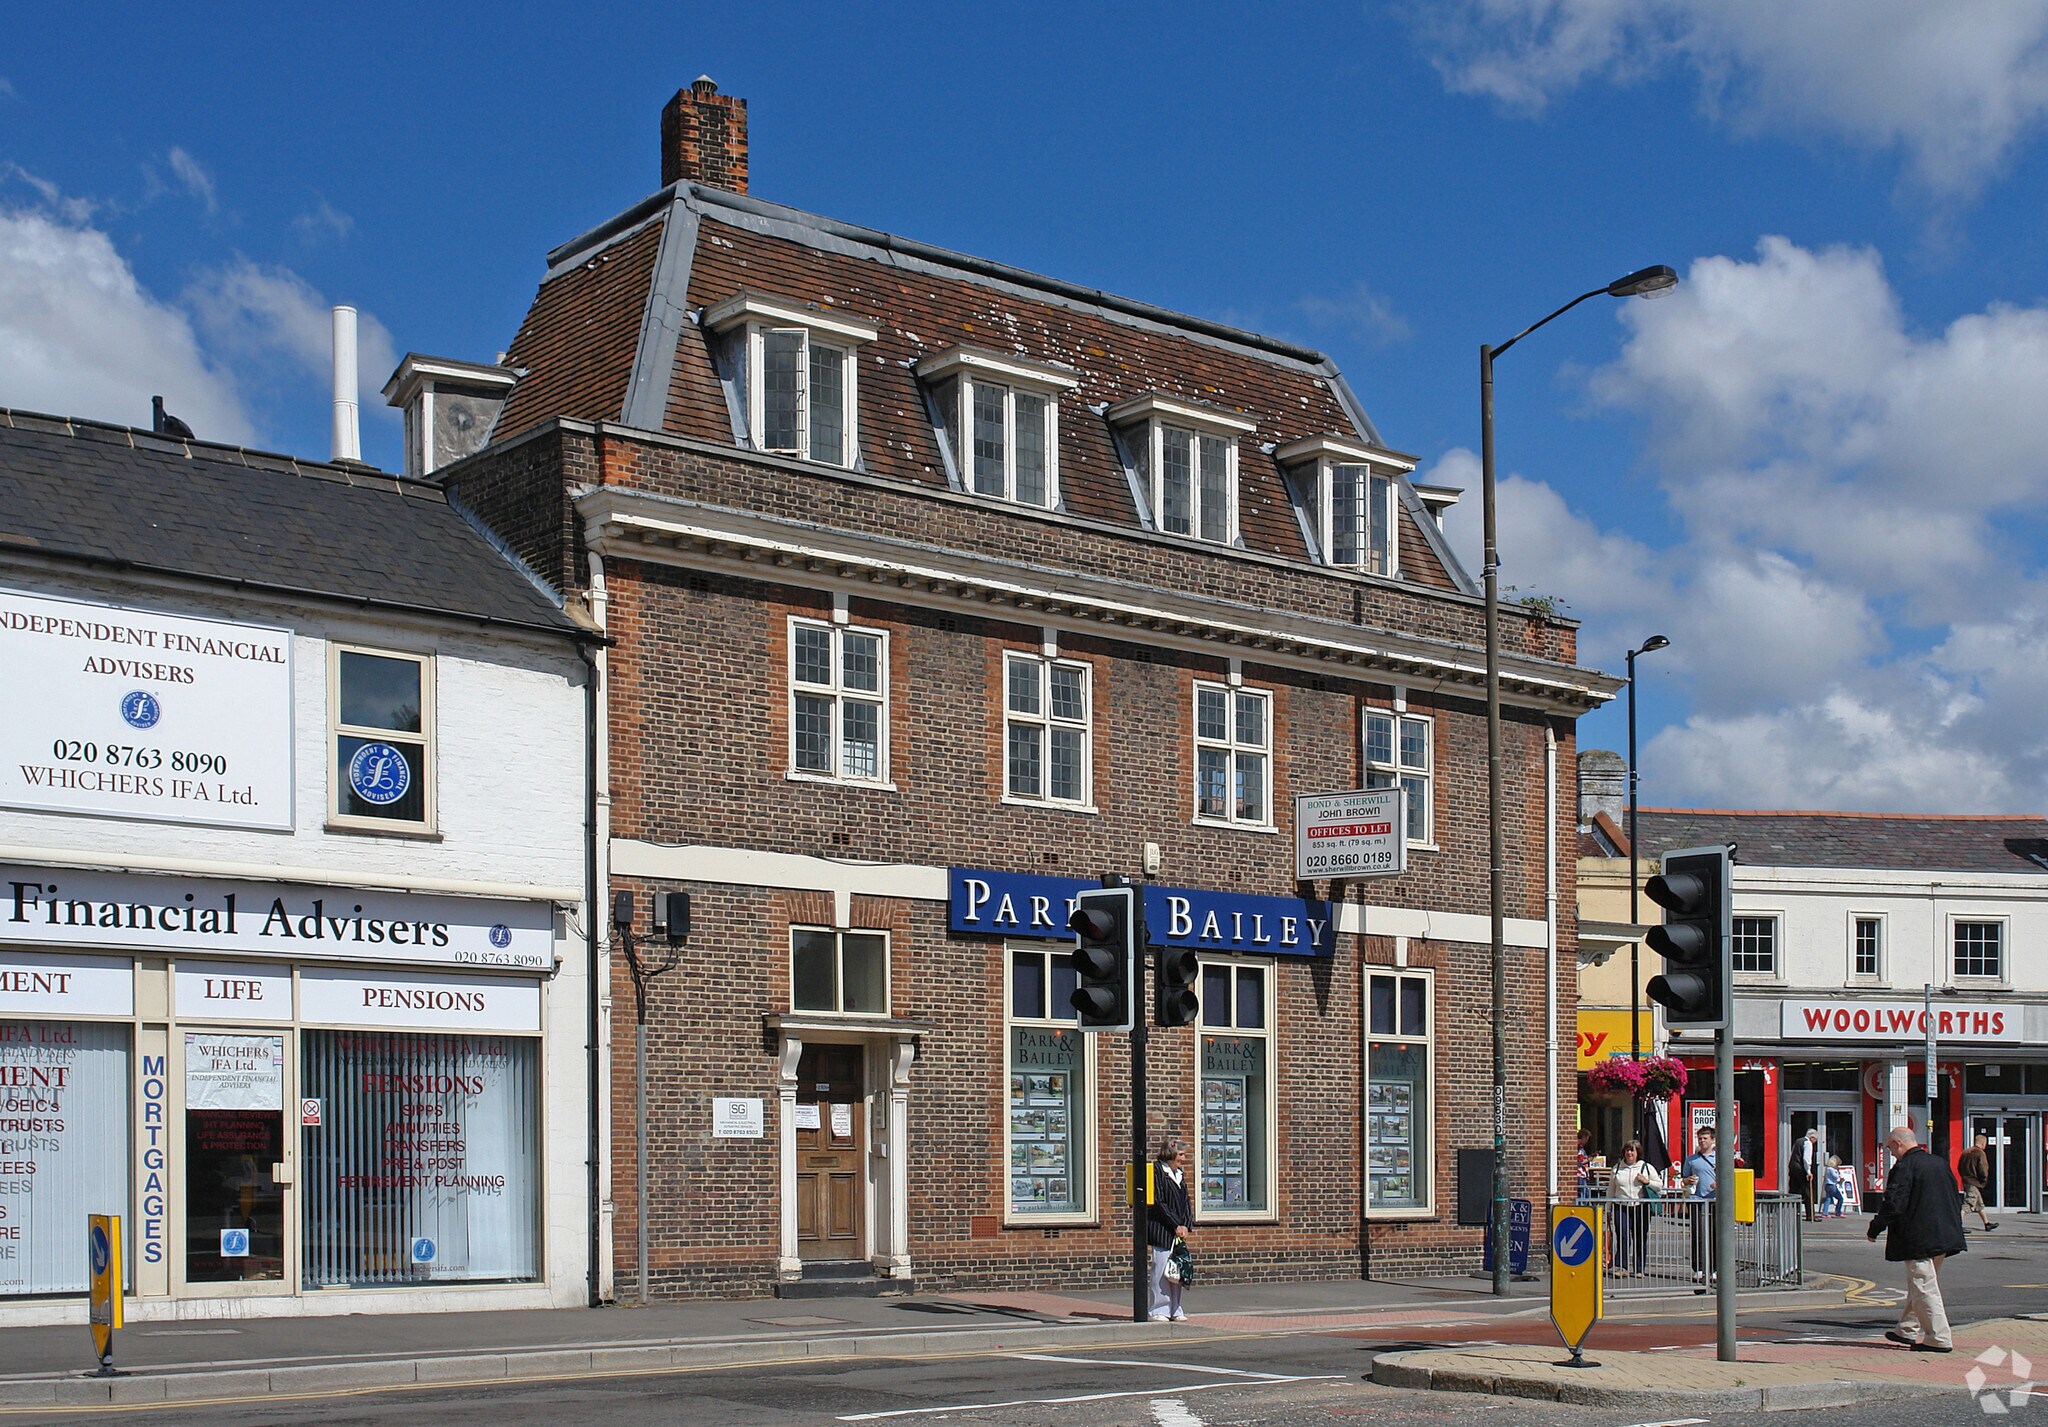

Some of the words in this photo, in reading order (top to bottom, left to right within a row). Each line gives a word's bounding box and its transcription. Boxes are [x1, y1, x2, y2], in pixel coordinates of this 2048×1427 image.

[163, 633, 286, 664] FINANCIAL
[83, 656, 194, 684] ADVISERS
[54, 739, 98, 762] 020
[106, 744, 162, 769] 8763
[171, 751, 227, 775] 8090
[352, 746, 378, 786] INDEPENDENT
[392, 754, 407, 790] FINANCIAL
[19, 764, 164, 797] WHICHERS
[171, 779, 210, 801] IFA
[217, 784, 258, 806] Ltd.
[362, 788, 396, 801] ADVISER
[1307, 800, 1332, 809] BOND
[1344, 796, 1391, 807] SHERWILL
[1310, 826, 1351, 837] OFFICES
[1354, 824, 1367, 834] TO
[1371, 824, 1389, 834] LET
[1306, 856, 1327, 867] 020
[1331, 854, 1359, 866] 8660
[1363, 851, 1392, 864] 0189
[1307, 863, 1391, 874] www.sherwillbrown.co.uk
[8, 881, 239, 935] Financial
[258, 896, 450, 948] Advisers
[455, 951, 478, 964] 020
[481, 953, 510, 965] 8763
[514, 955, 542, 967] 8090
[204, 978, 263, 1002] LIFE
[362, 987, 486, 1012] PENSIONS
[1803, 1008, 2005, 1034] WOOLWORTHS
[40, 1026, 77, 1044] Ltd.
[1019, 1032, 1059, 1048] PARK
[1059, 1035, 1074, 1052] &
[199, 1045, 270, 1058] WHICHERS
[478, 1040, 507, 1056] Ltd.
[1207, 1040, 1242, 1054] PARK
[1242, 1043, 1256, 1059] &
[1019, 1048, 1074, 1065] BAILEY
[1207, 1056, 1256, 1071] BAILEY
[211, 1059, 232, 1070] IFA
[236, 1060, 256, 1071] Ltd.
[362, 1073, 484, 1095] PENSIONS
[401, 1104, 444, 1117] SIPPS
[731, 1104, 746, 1114] SG
[0, 1118, 65, 1132] TRUSTS
[385, 1122, 461, 1134] ANNUITIES
[383, 1140, 466, 1152] TRANSFERS
[143, 1056, 164, 1264] MORTGAGES
[381, 1158, 410, 1170] PRE
[414, 1158, 423, 1170] &
[428, 1158, 465, 1170] POST
[435, 1176, 505, 1188] PLANNING
[1520, 1203, 1528, 1213] &
